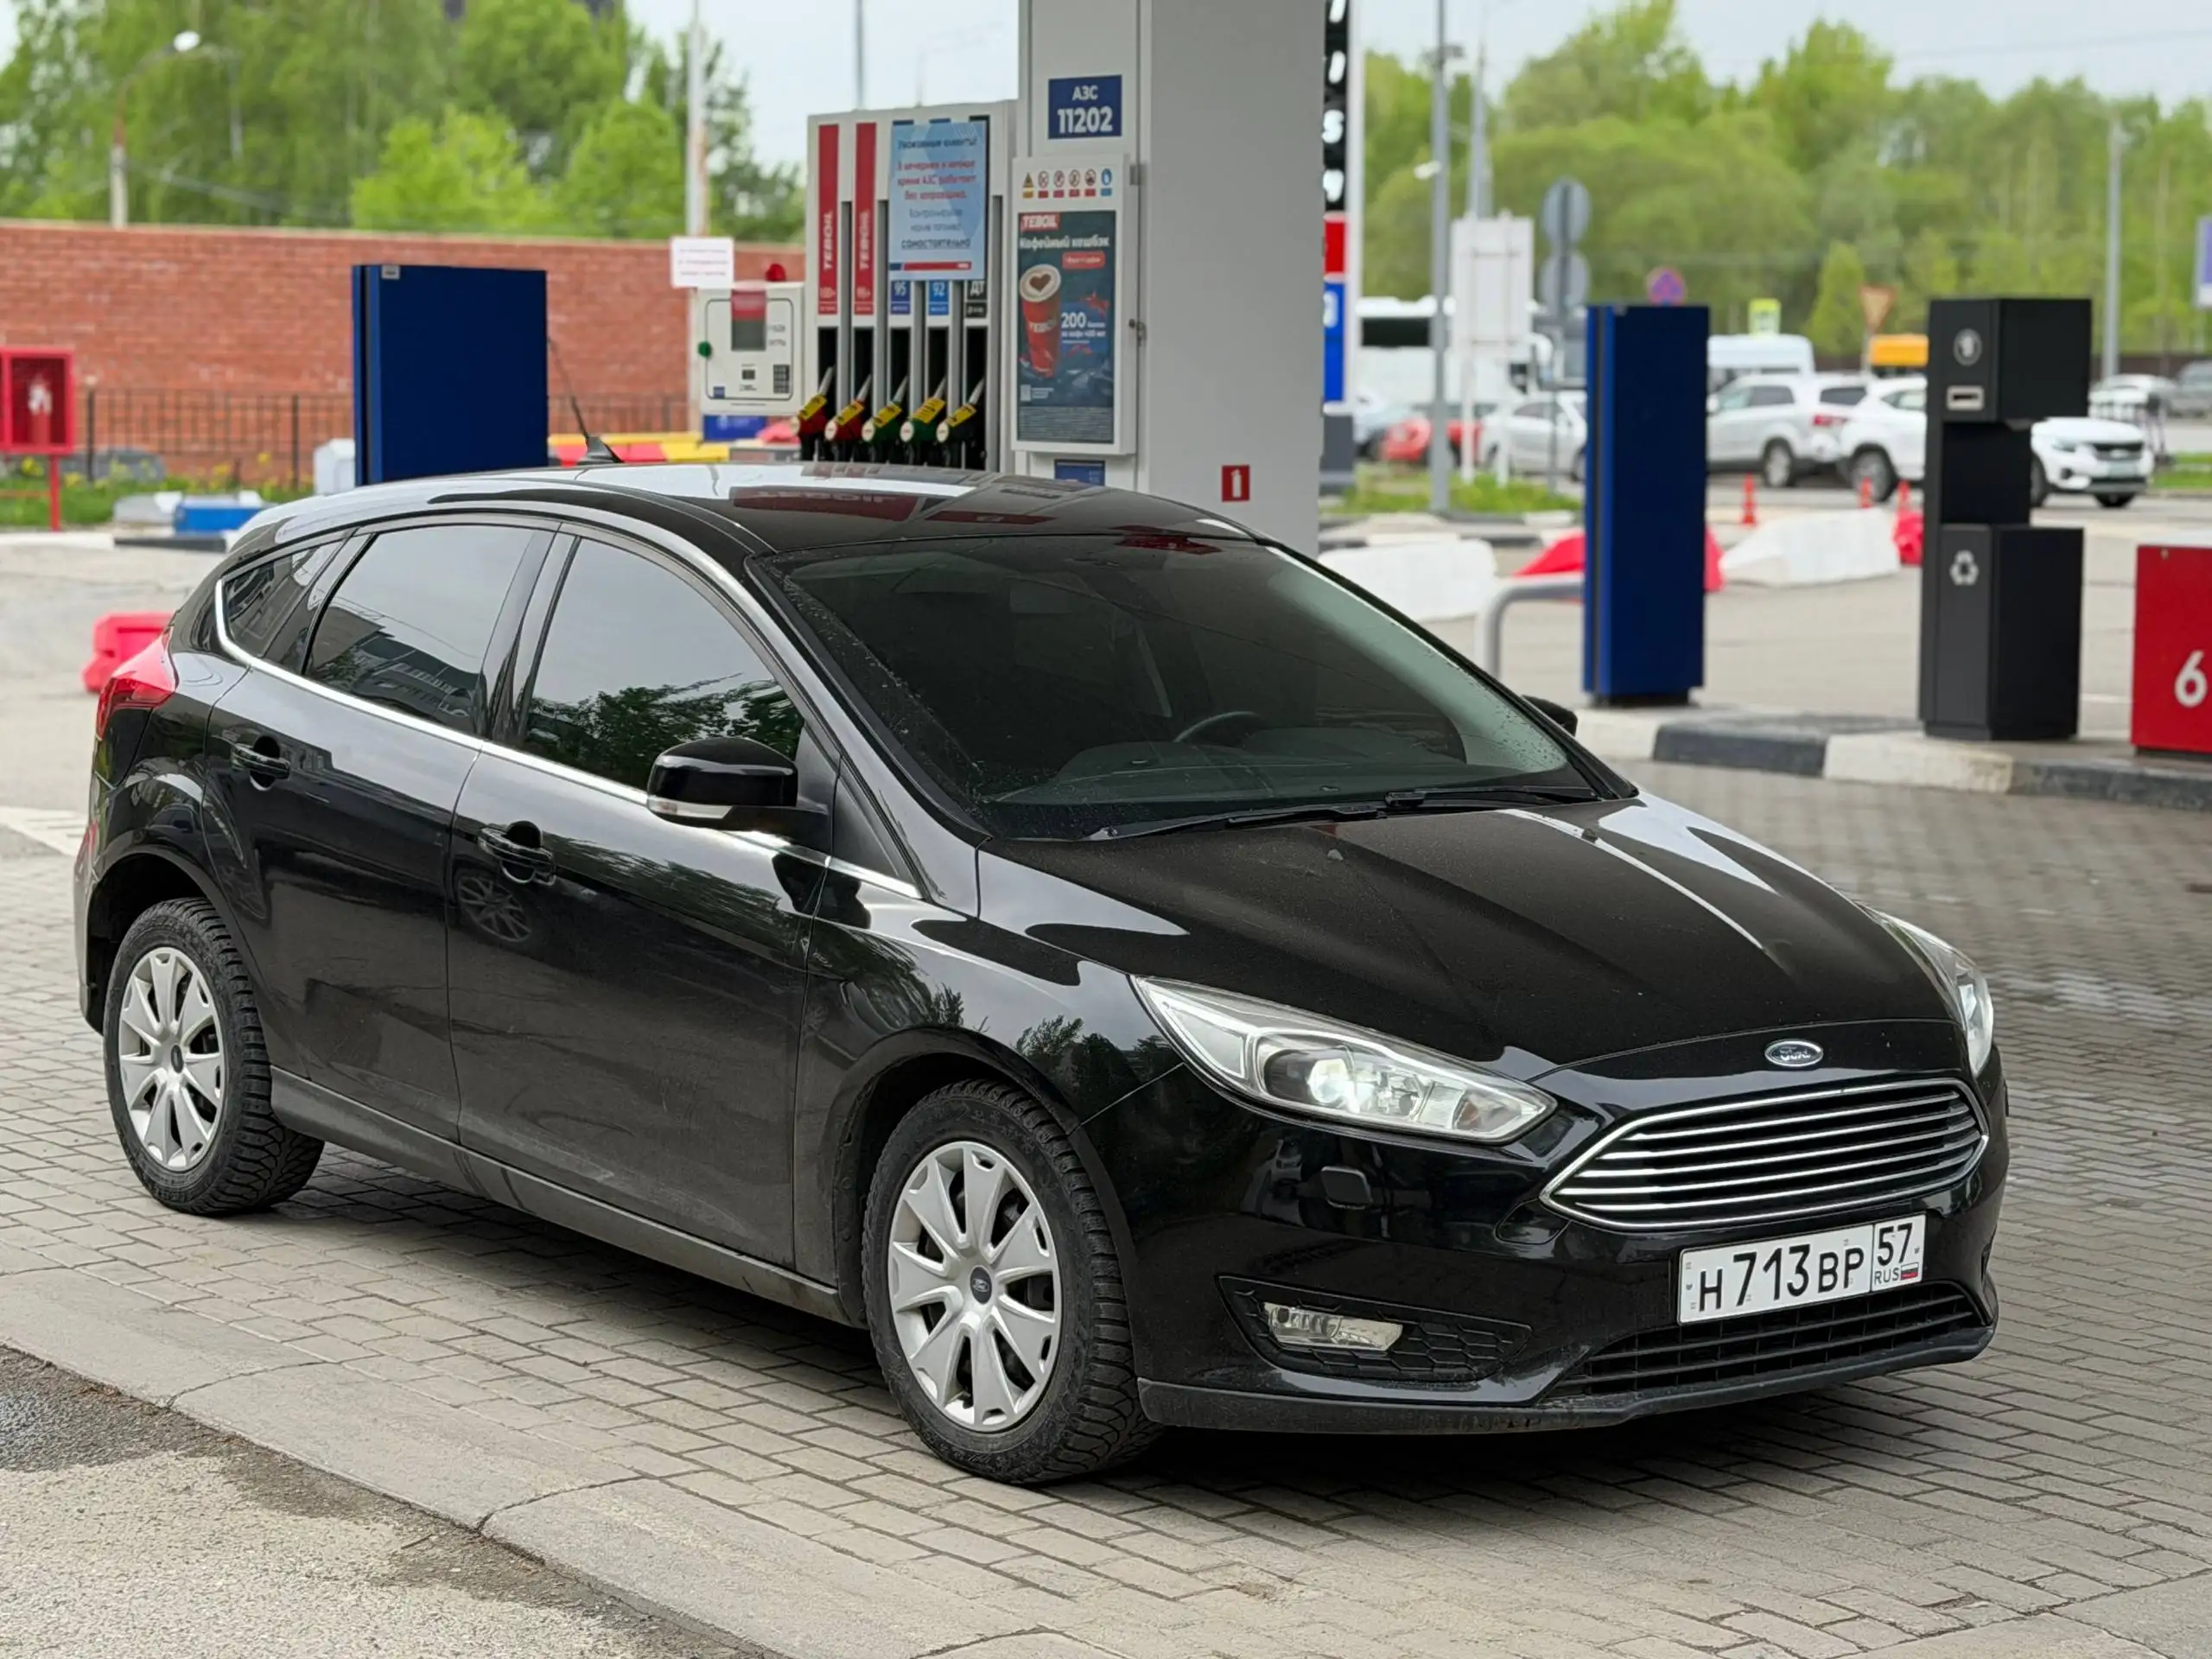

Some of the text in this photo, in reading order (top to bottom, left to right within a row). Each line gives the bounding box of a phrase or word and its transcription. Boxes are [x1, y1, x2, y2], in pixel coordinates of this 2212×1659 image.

[1072, 85, 1098, 101] АЗС
[1057, 105, 1113, 134] 11202
[932, 281, 946, 297] 92
[1060, 311, 1087, 329] 200
[2173, 648, 2209, 708] 6
[1876, 1222, 1913, 1267] 57
[1873, 1267, 1899, 1285] RUS
